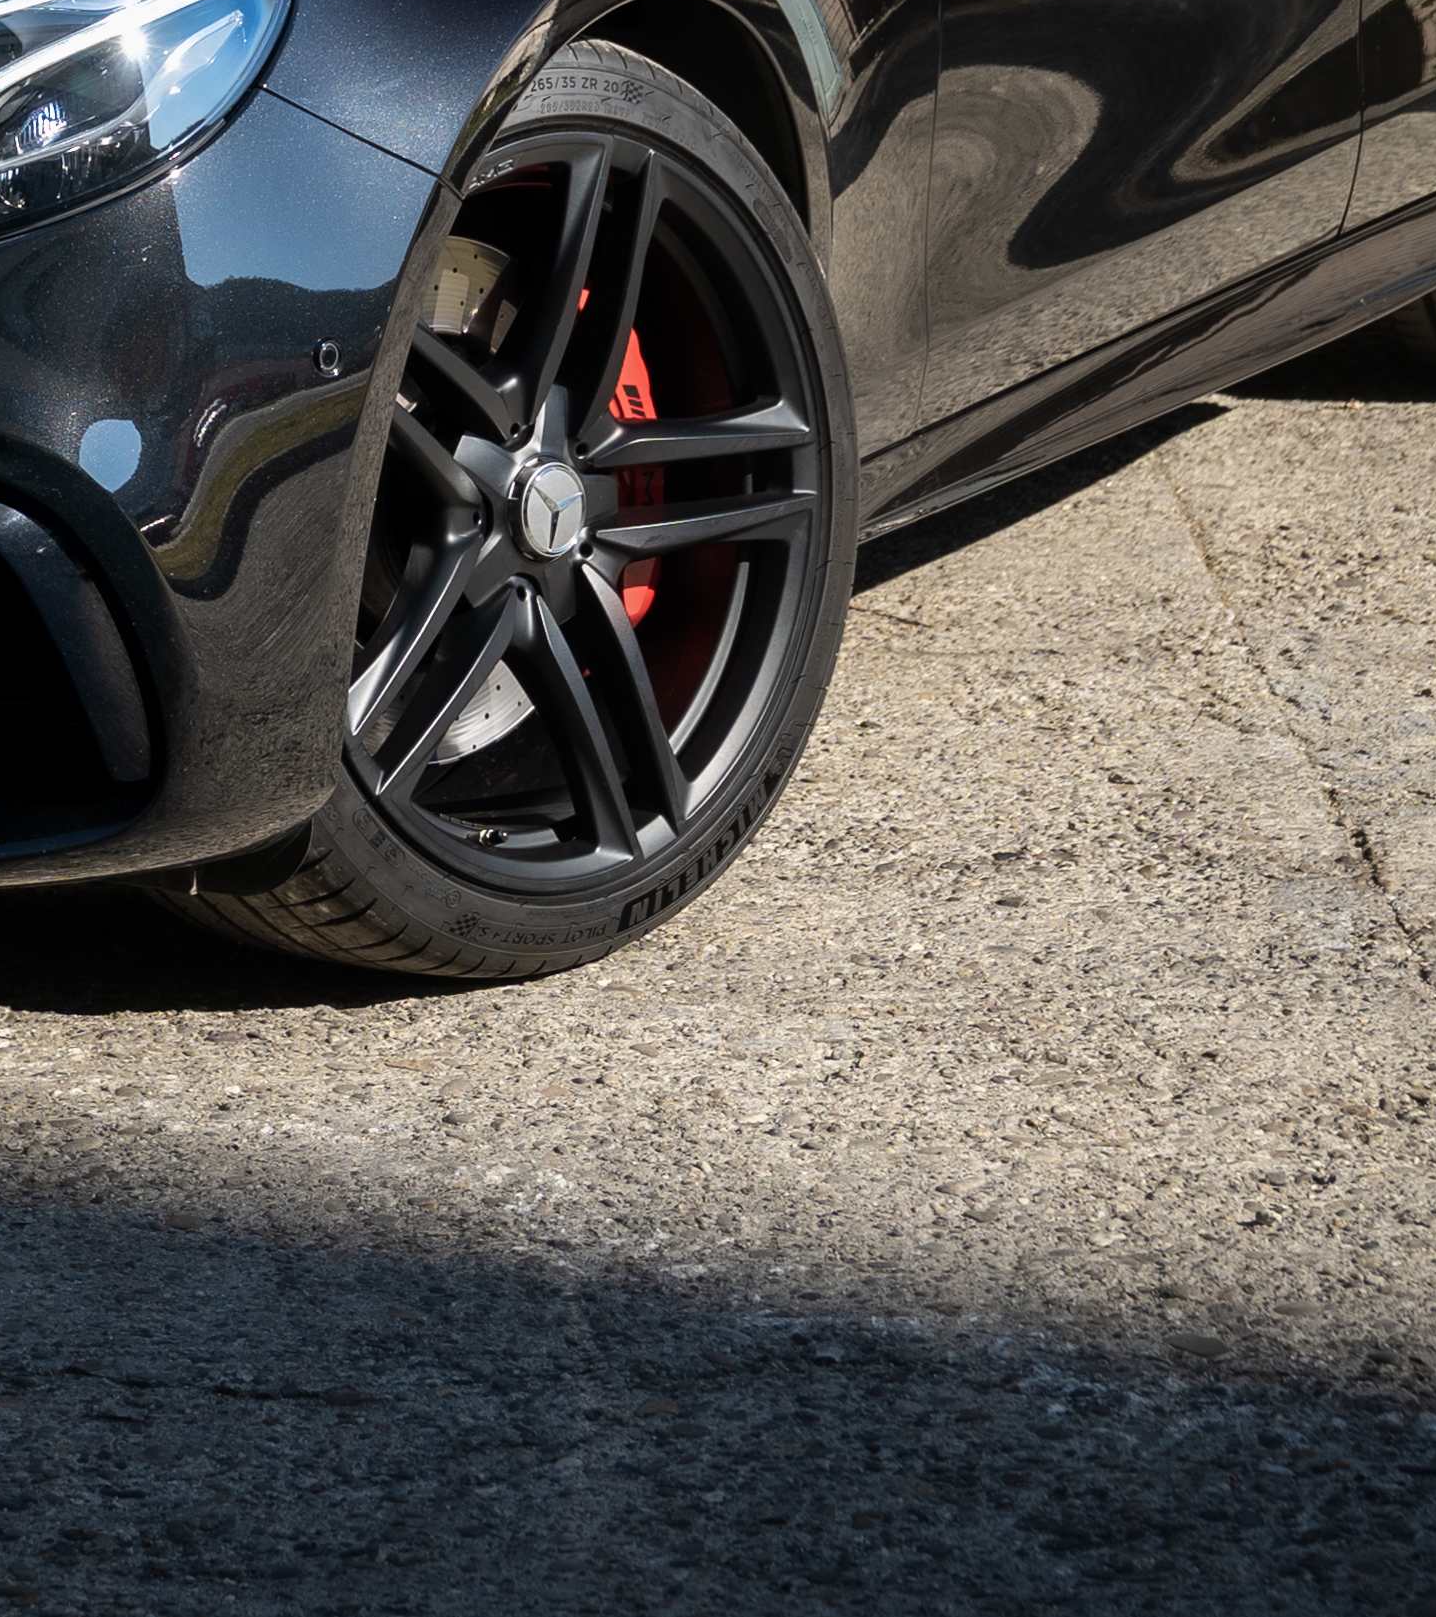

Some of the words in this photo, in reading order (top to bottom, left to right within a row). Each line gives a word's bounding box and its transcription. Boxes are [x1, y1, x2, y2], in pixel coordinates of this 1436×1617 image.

[581, 76, 598, 91] ZR
[603, 79, 620, 94] 20
[628, 780, 770, 929] MICHELIN
